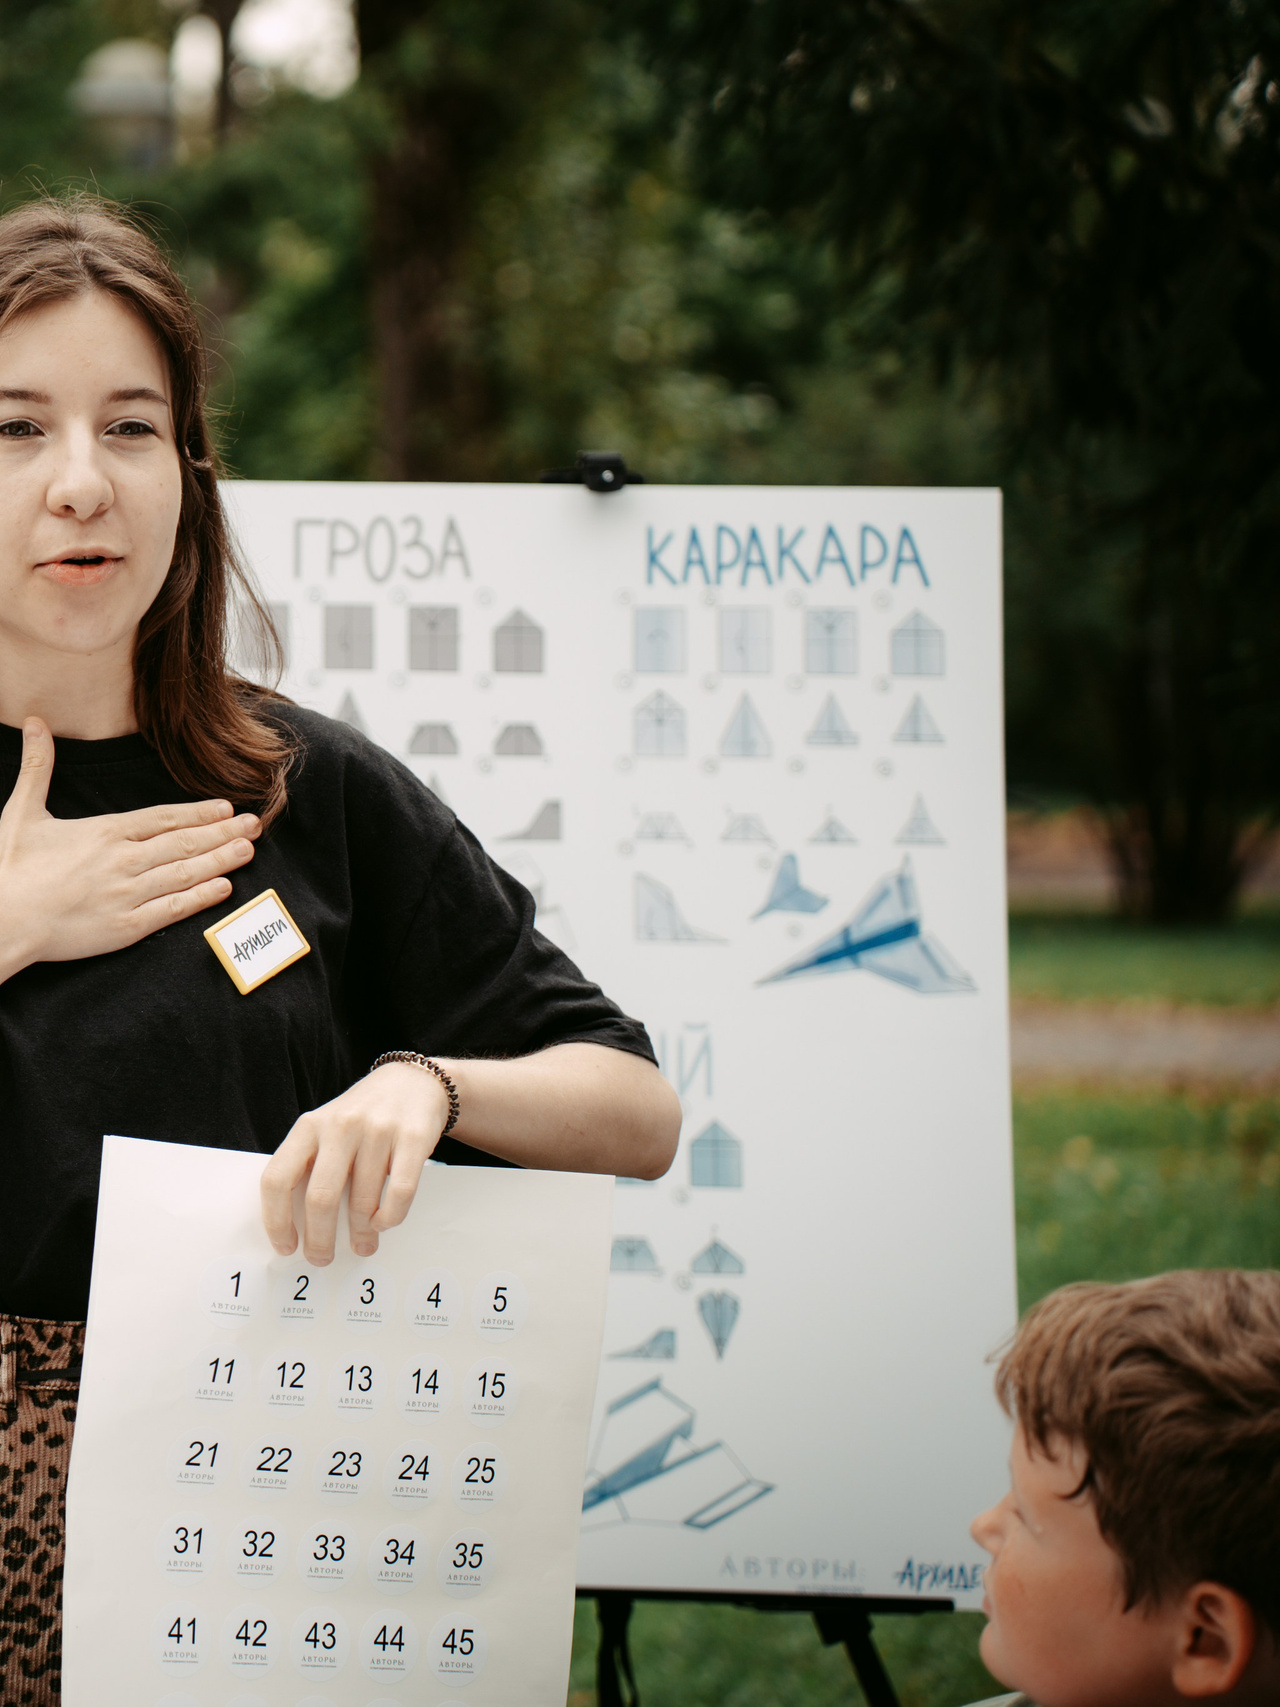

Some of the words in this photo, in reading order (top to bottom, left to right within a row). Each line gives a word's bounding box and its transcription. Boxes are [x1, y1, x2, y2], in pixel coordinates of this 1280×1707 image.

[292, 514, 472, 584] ГРОЗА
[645, 523, 931, 588] КАРАКАРА
[233, 918, 288, 963] АРХИДЕТИ
[230, 1271, 242, 1298] 1
[293, 1274, 310, 1301] 2
[360, 1278, 375, 1305] 3
[426, 1282, 442, 1309] 4
[492, 1286, 508, 1313] 5
[209, 1357, 235, 1385] 11
[277, 1361, 306, 1389] 12
[345, 1364, 373, 1392] 13
[412, 1368, 439, 1395] 14
[478, 1371, 506, 1399] 15
[184, 1440, 219, 1468] 21
[256, 1446, 293, 1473] 22
[327, 1450, 362, 1478] 23
[397, 1454, 430, 1481] 24
[464, 1457, 496, 1484] 25
[173, 1526, 203, 1555] 31
[242, 1530, 276, 1558] 32
[313, 1534, 346, 1562] 33
[383, 1538, 415, 1566] 34
[452, 1542, 484, 1569] 35
[893, 1556, 985, 1592] АРХИДЕ
[167, 1616, 196, 1645] 41
[235, 1619, 268, 1647] 42
[304, 1621, 337, 1650] 43
[373, 1624, 405, 1653] 44
[441, 1627, 474, 1656] 45
